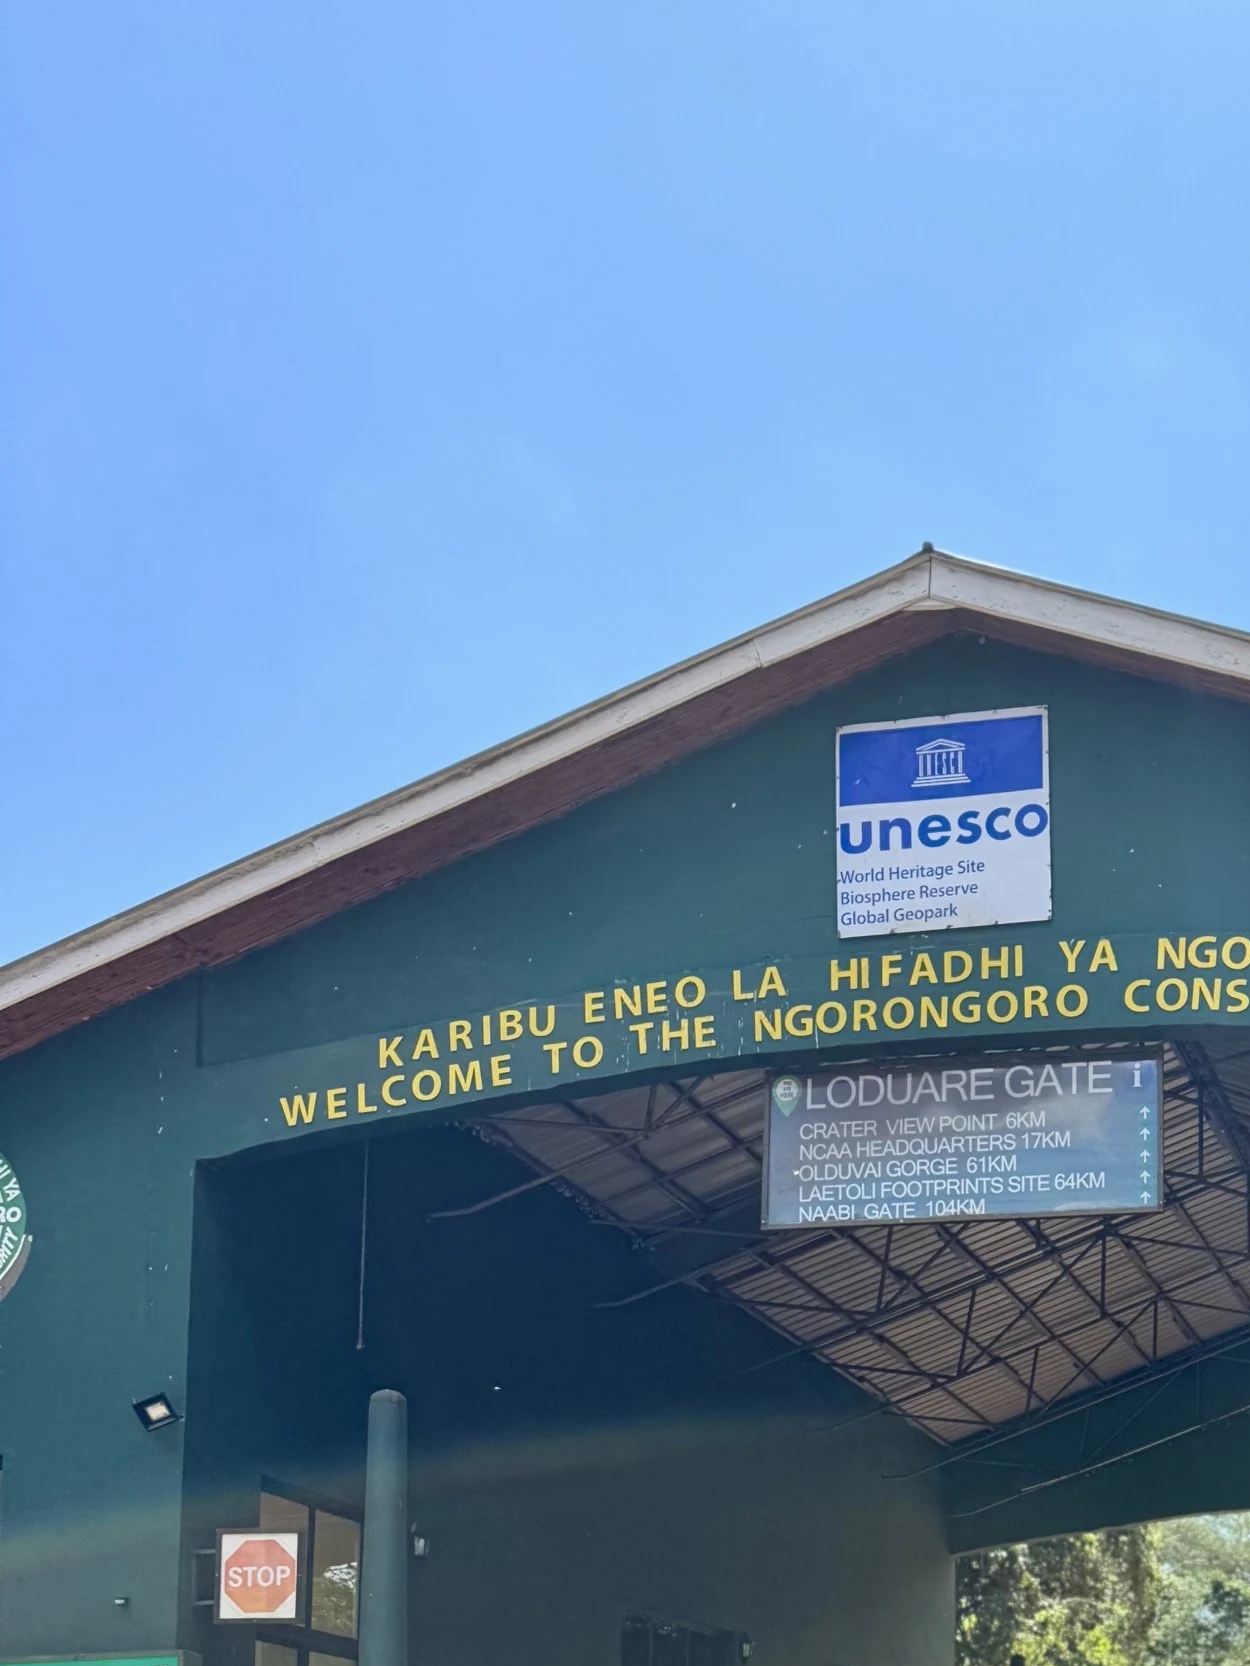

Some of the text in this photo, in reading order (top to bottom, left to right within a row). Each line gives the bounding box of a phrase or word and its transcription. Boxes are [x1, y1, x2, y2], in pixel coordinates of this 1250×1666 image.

[840, 804, 1048, 855] unesco
[840, 860, 985, 885] World Heritage Site
[841, 883, 978, 906] Biosphere Reserve
[841, 903, 958, 926] Global Geopark
[378, 1005, 556, 1069] KARIBU
[584, 976, 706, 1024] ENEO
[732, 966, 787, 1001] LA
[829, 945, 1024, 992] HIFADHI
[1059, 939, 1119, 973] YA
[279, 1054, 512, 1126] WELCOME
[543, 1036, 603, 1074] TO
[629, 1016, 716, 1054] THE
[754, 984, 1088, 1042] NGORONGORO
[805, 1067, 995, 1110] LODUARE
[1004, 1060, 1113, 1099] GATE
[799, 1110, 1046, 1140] CRATER VIEW POINT 6KM
[799, 1130, 1071, 1161] NCAA HEADQUARTERS 17KM
[799, 1154, 1017, 1181] OLDUVAI GORGE 61KM
[3, 1177, 20, 1202] YA
[799, 1171, 1106, 1202] LAETOLI FOOTPRINTS SITE 64KM
[799, 1198, 986, 1222] NAABI GATE 104KM
[228, 1565, 291, 1588] STOP
